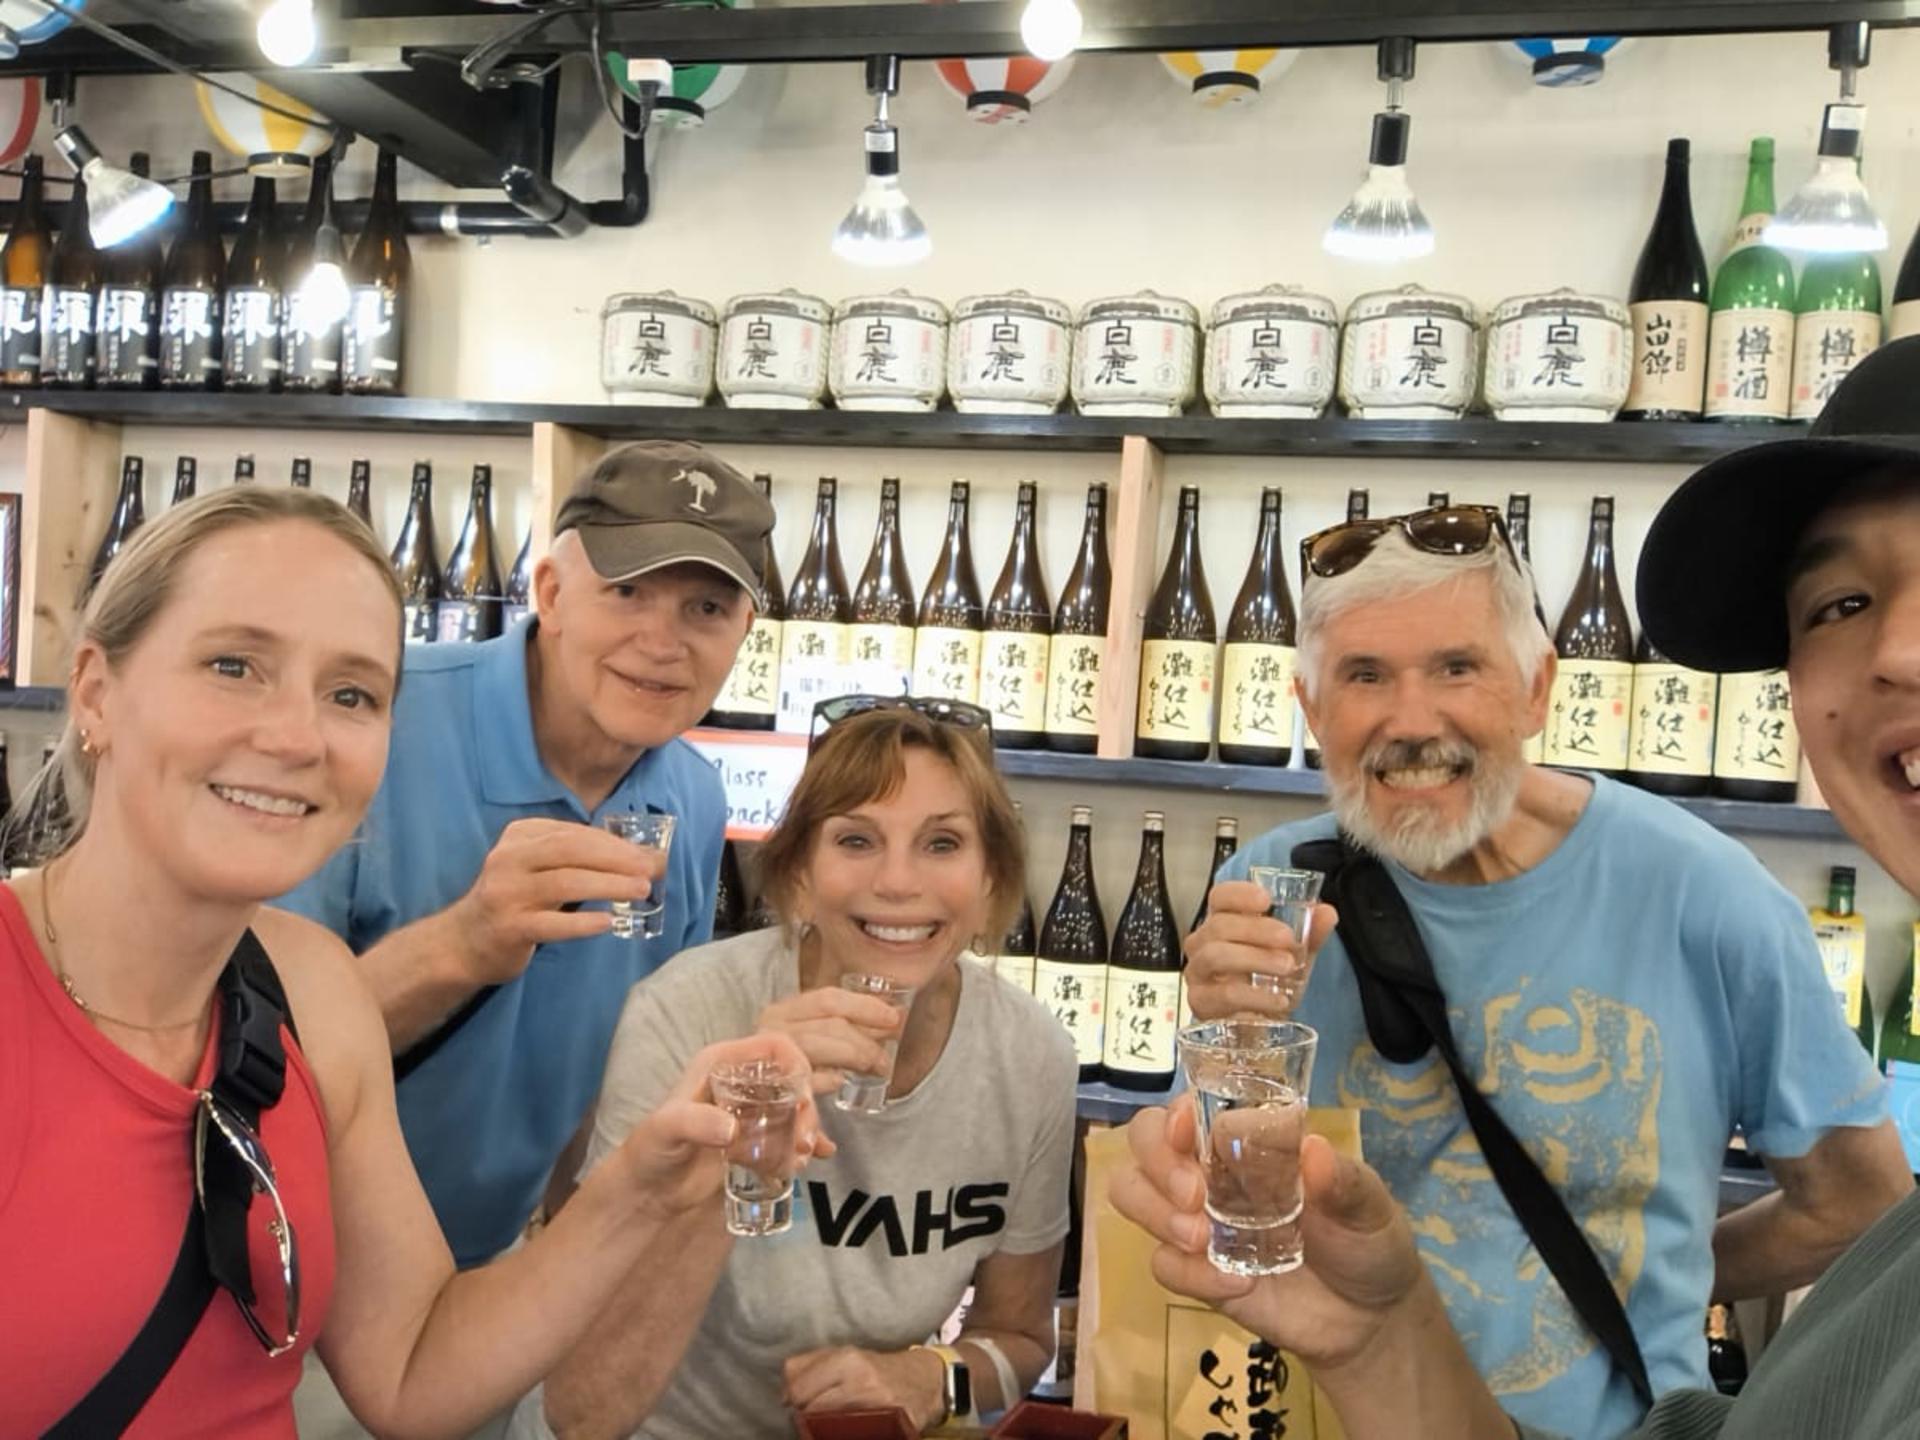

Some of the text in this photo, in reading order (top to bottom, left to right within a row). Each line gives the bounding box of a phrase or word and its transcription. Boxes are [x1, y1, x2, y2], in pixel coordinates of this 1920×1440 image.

[628, 314, 672, 377] 白鹿
[738, 315, 778, 378] 白鹿
[856, 317, 898, 382] 白鹿
[981, 315, 1025, 382] 白鹿
[1095, 319, 1138, 384] 白鹿
[1240, 319, 1288, 388] 白鹿
[1399, 316, 1447, 388] 白鹿
[1532, 315, 1585, 387] 白鹿
[1641, 313, 1673, 383] 山田錦
[1733, 326, 1772, 400] 樽酒
[743, 629, 774, 703] 灘仕込
[994, 641, 1027, 720] 灘仕込
[1066, 644, 1100, 724] 灘仕込
[1158, 649, 1194, 730] 灘仕込
[1247, 653, 1281, 735] 灘仕込
[1564, 671, 1604, 755] 灘仕込
[1651, 676, 1690, 762] 灘仕込
[1753, 682, 1792, 768] 灘仕込
[1126, 982, 1158, 1061] 灘仕込
